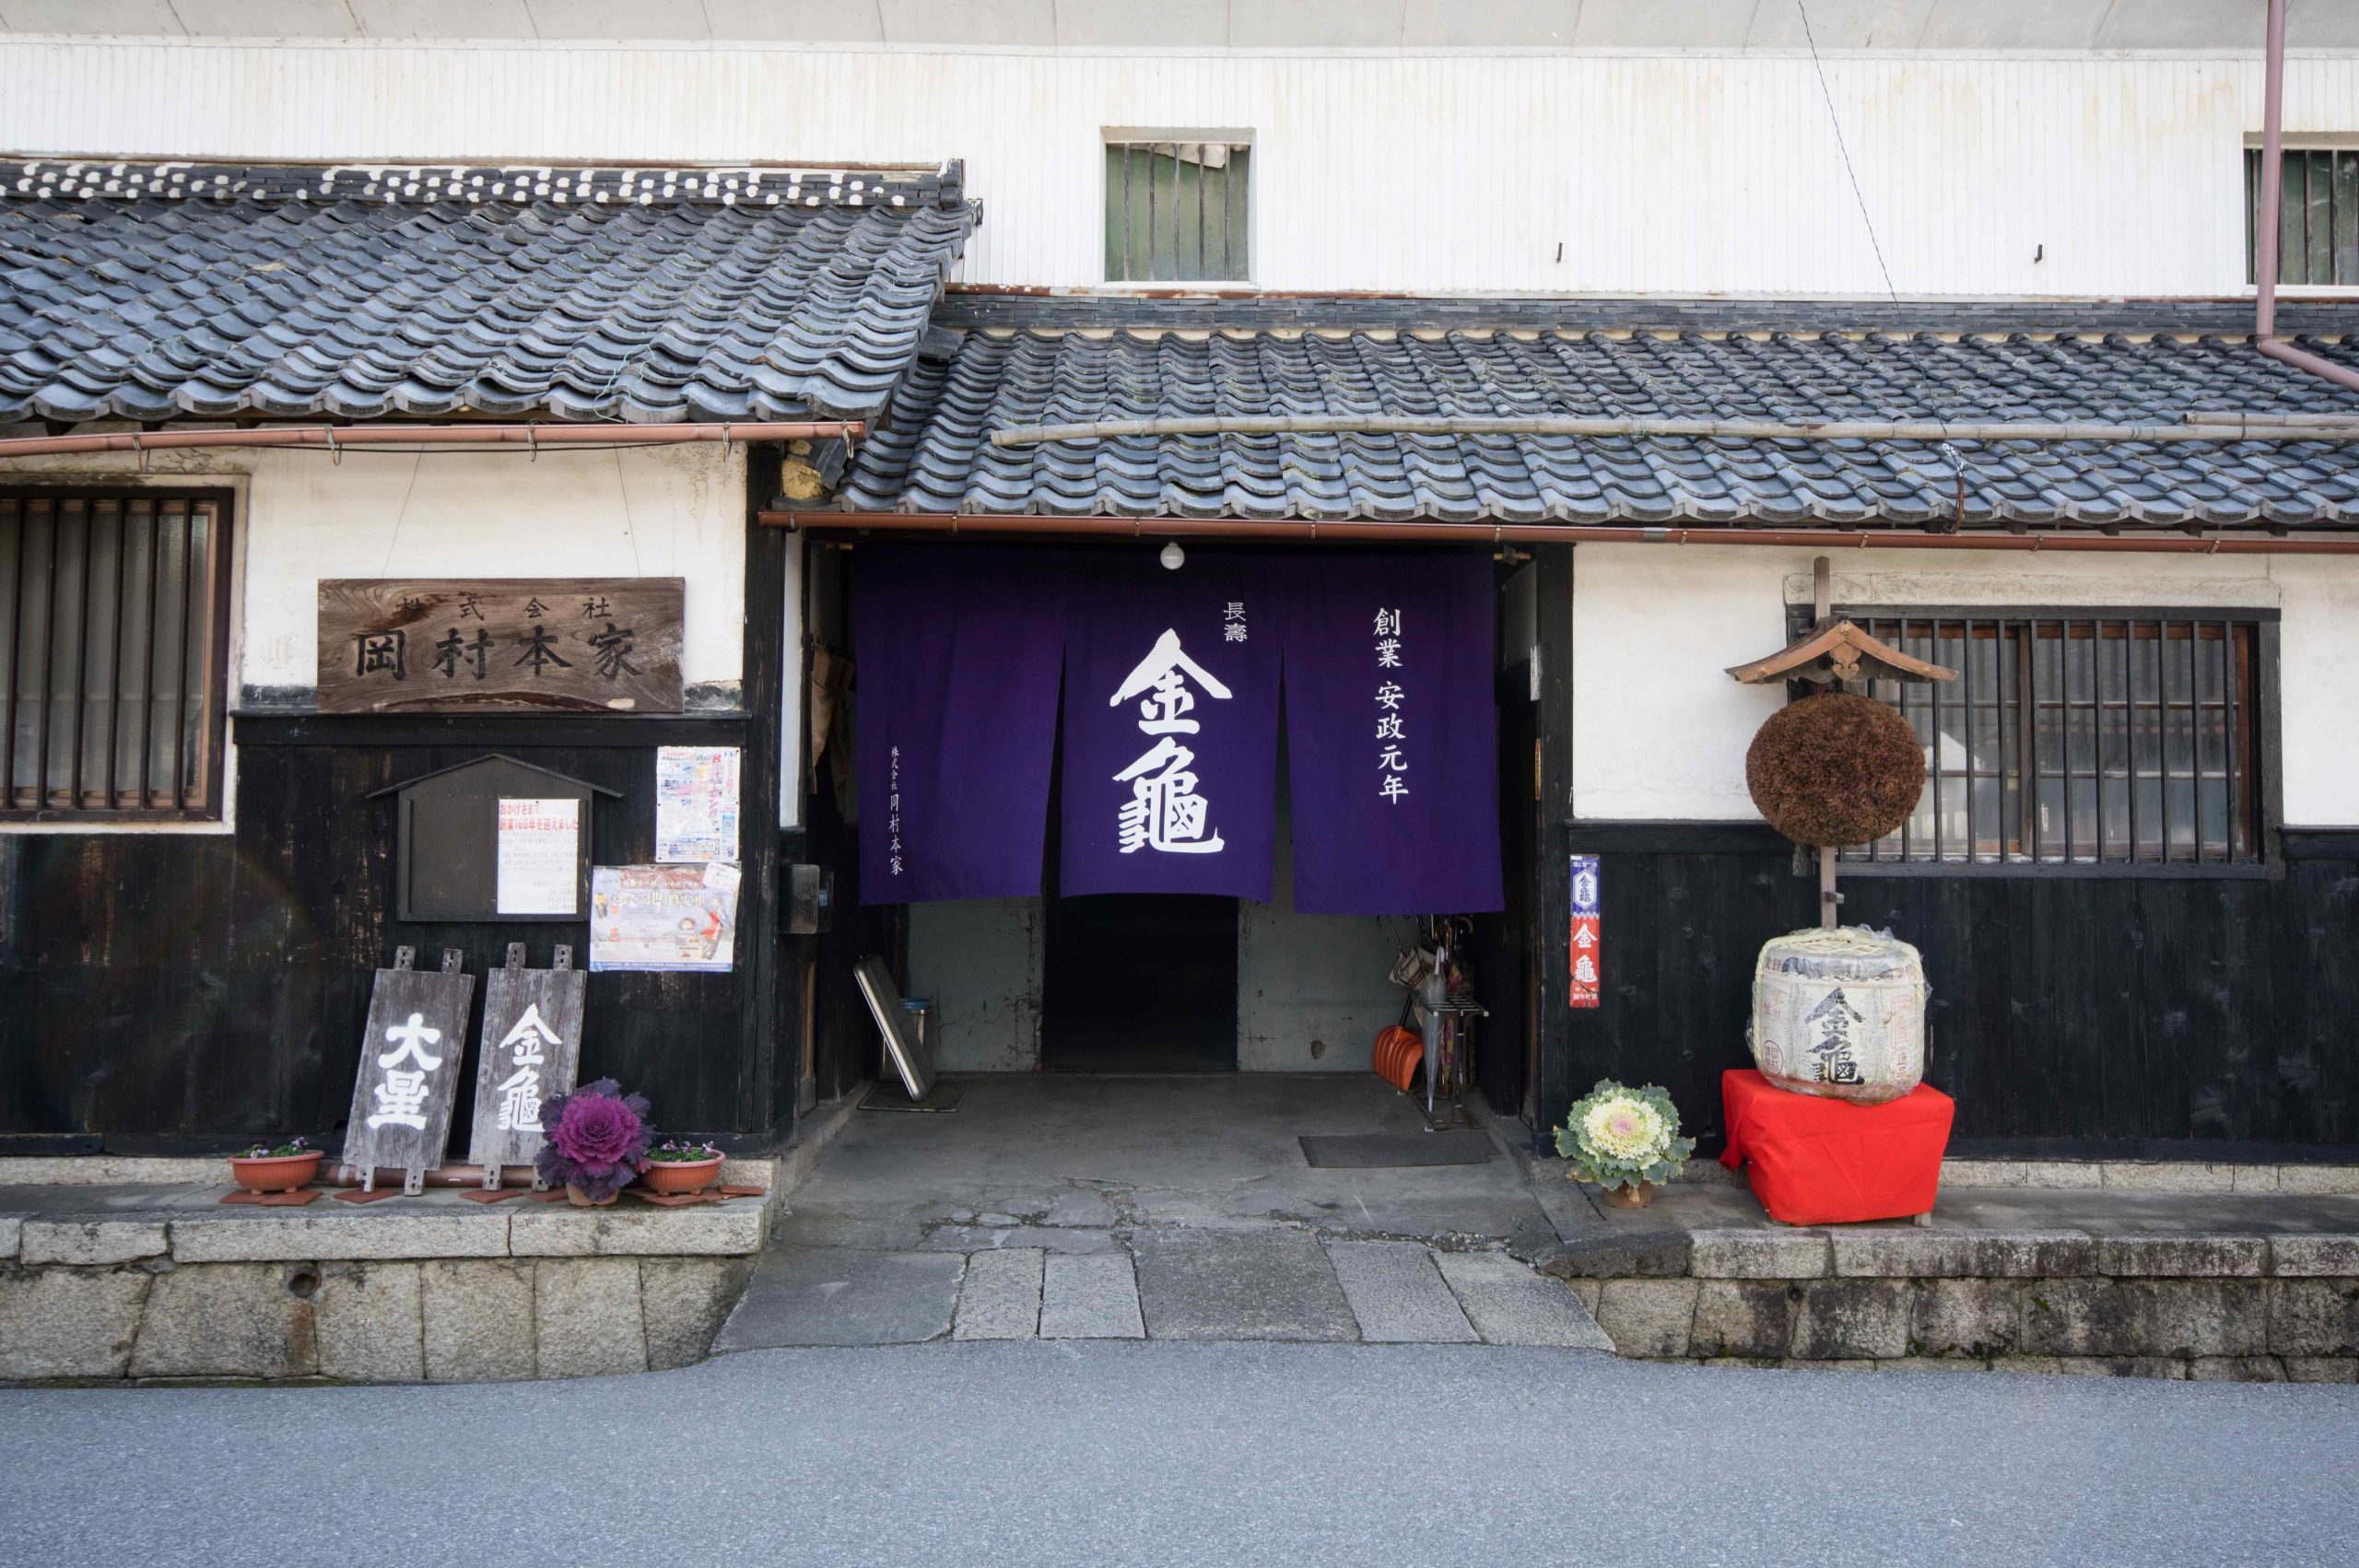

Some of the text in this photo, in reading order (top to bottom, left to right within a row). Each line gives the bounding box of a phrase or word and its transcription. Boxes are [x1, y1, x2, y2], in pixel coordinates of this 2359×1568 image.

[397, 596, 613, 621] 株式会社
[354, 623, 642, 681] 岡村本家
[1373, 607, 1410, 805] 創業 安政元年
